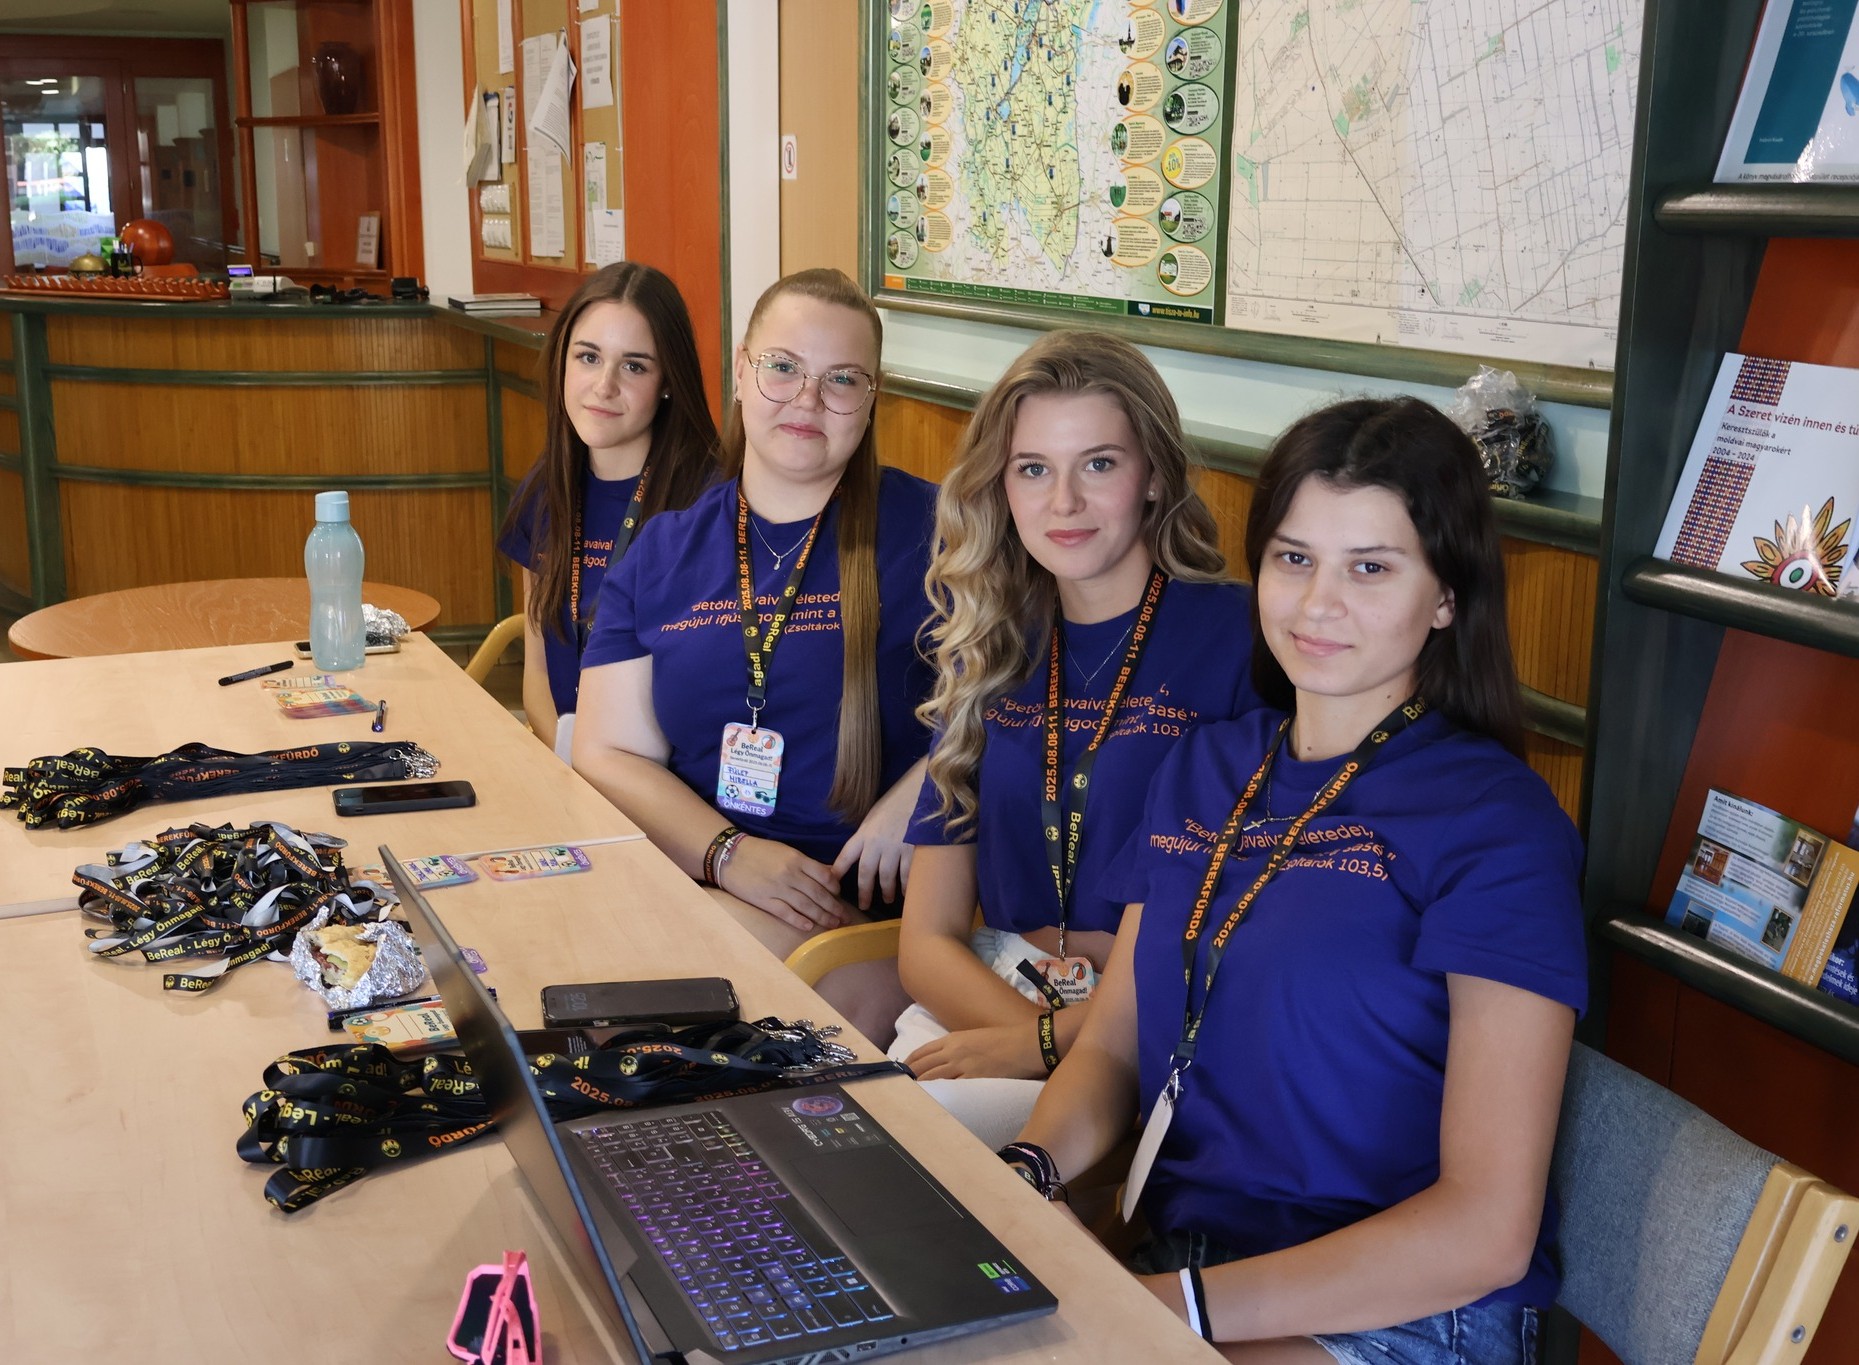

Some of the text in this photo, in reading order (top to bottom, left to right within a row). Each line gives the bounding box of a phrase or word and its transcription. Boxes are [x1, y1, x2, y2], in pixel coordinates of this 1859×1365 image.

[1720, 422, 1776, 439] Keresztszülők a
[1727, 404, 1736, 416] A
[1738, 406, 1773, 423] Szeret
[1774, 411, 1802, 427] vizén
[1802, 415, 1833, 433] innen
[1834, 421, 1847, 434] és
[1712, 446, 1756, 462] 2004 2024
[1716, 434, 1792, 457] moldvai magyarokért
[583, 538, 614, 551] avaival
[738, 490, 753, 611] 2025.08.08-11. BEREKF
[583, 555, 608, 569] ágod,
[691, 598, 738, 612] etölti
[796, 591, 841, 604] életed
[661, 616, 713, 632] megújul
[791, 609, 824, 621] mint
[827, 610, 836, 619] a
[784, 622, 841, 634] (Zsoltárok
[749, 652, 764, 687] agad!
[1088, 571, 1164, 752] 2025.08.08-11. BEREKFÜRDŐ
[1000, 697, 1045, 714] "Betö
[1062, 697, 1107, 711] avaiva
[984, 707, 1026, 728] gújul
[730, 748, 774, 762] Légy Önmagad!
[741, 742, 764, 753] BeReal
[1045, 710, 1059, 802] 2025.08.08-11.
[56, 758, 101, 779] BeReal.
[723, 797, 767, 816] ÖNKÉNTES
[1066, 811, 1082, 864] BeReal.
[1185, 751, 1273, 941] 25.08.08-11. BEREKFÜRDŐ
[176, 844, 207, 872] BeReal.
[274, 841, 318, 877] BEREKFÜRDŐ
[1213, 761, 1359, 948] 2025.08.08-11. BEREKFÜRDŐ
[125, 861, 163, 886] BeReal.
[130, 930, 155, 948] Légy
[156, 904, 206, 931] Önmagad!
[256, 907, 308, 938] BEREKFÜRDŐ
[146, 944, 186, 961] BeReal.
[193, 937, 221, 950] Légy
[1053, 978, 1077, 987] BeReal
[1059, 986, 1088, 996] Önmagad!
[1042, 1016, 1053, 1050] BeReal.
[431, 1077, 480, 1096] eReal.
[428, 1120, 494, 1148] FÜRDŐ
[796, 1124, 825, 1146] CYBORG
